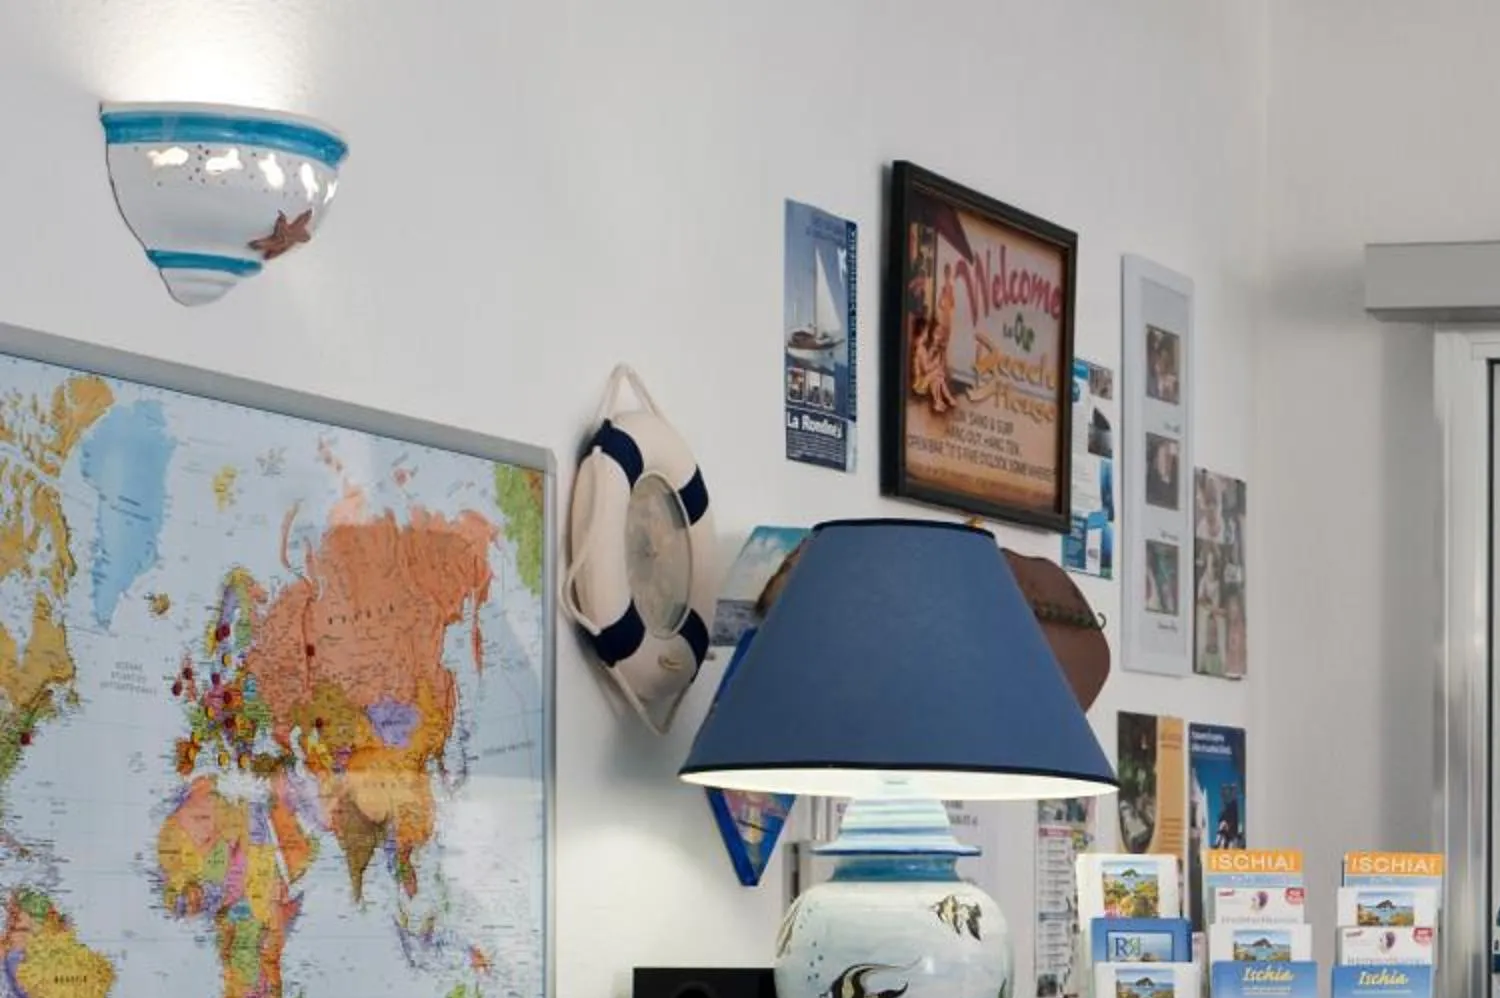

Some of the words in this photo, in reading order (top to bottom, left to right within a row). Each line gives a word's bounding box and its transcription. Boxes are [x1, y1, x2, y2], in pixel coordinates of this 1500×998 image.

[955, 245, 1062, 327] Welcome
[787, 411, 798, 428] La
[1242, 964, 1294, 983] Ischia
[1358, 967, 1409, 986] Ischia
